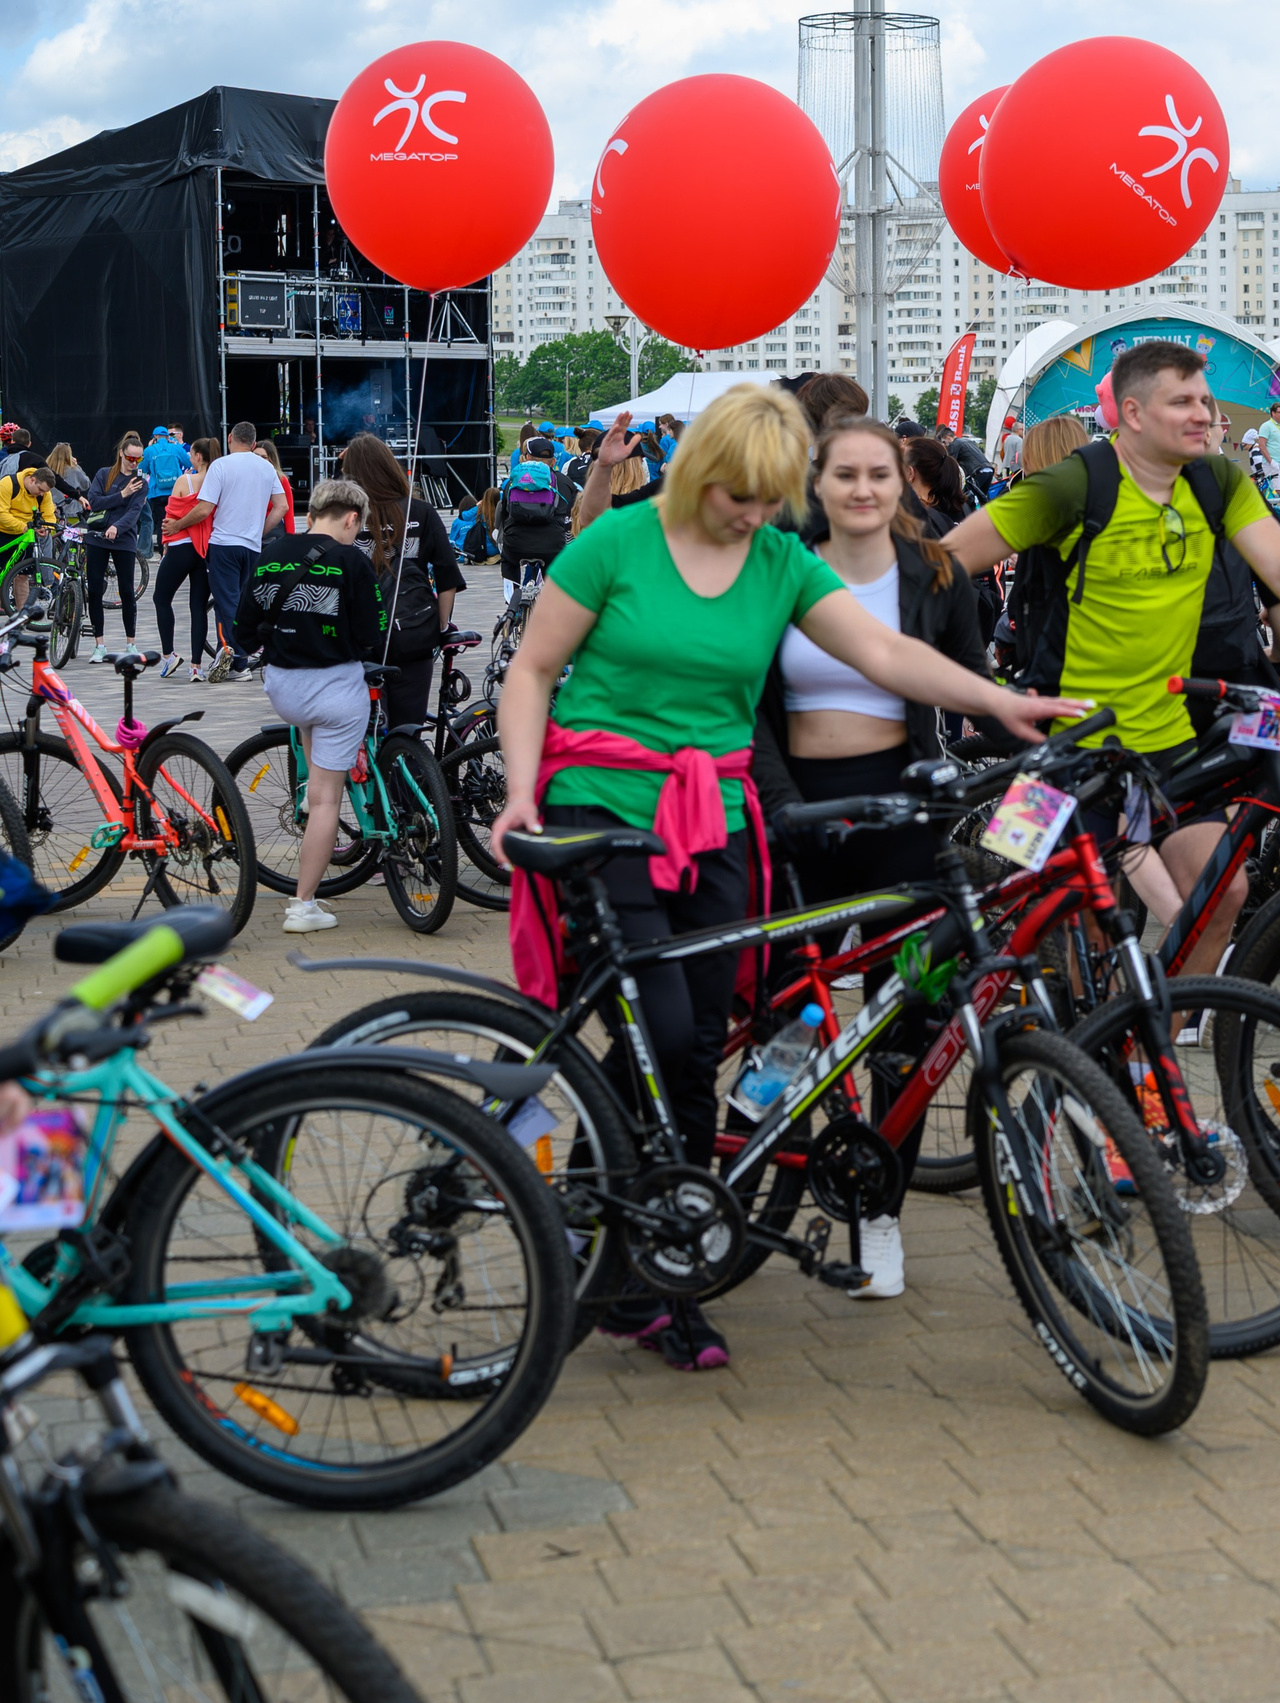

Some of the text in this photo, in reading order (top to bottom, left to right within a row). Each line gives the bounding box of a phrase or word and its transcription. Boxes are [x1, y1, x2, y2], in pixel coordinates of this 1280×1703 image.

[369, 152, 459, 162] MEGATOP
[1109, 162, 1178, 227] MEGATOP
[954, 344, 967, 382] Bank
[254, 562, 343, 577] EGAOP
